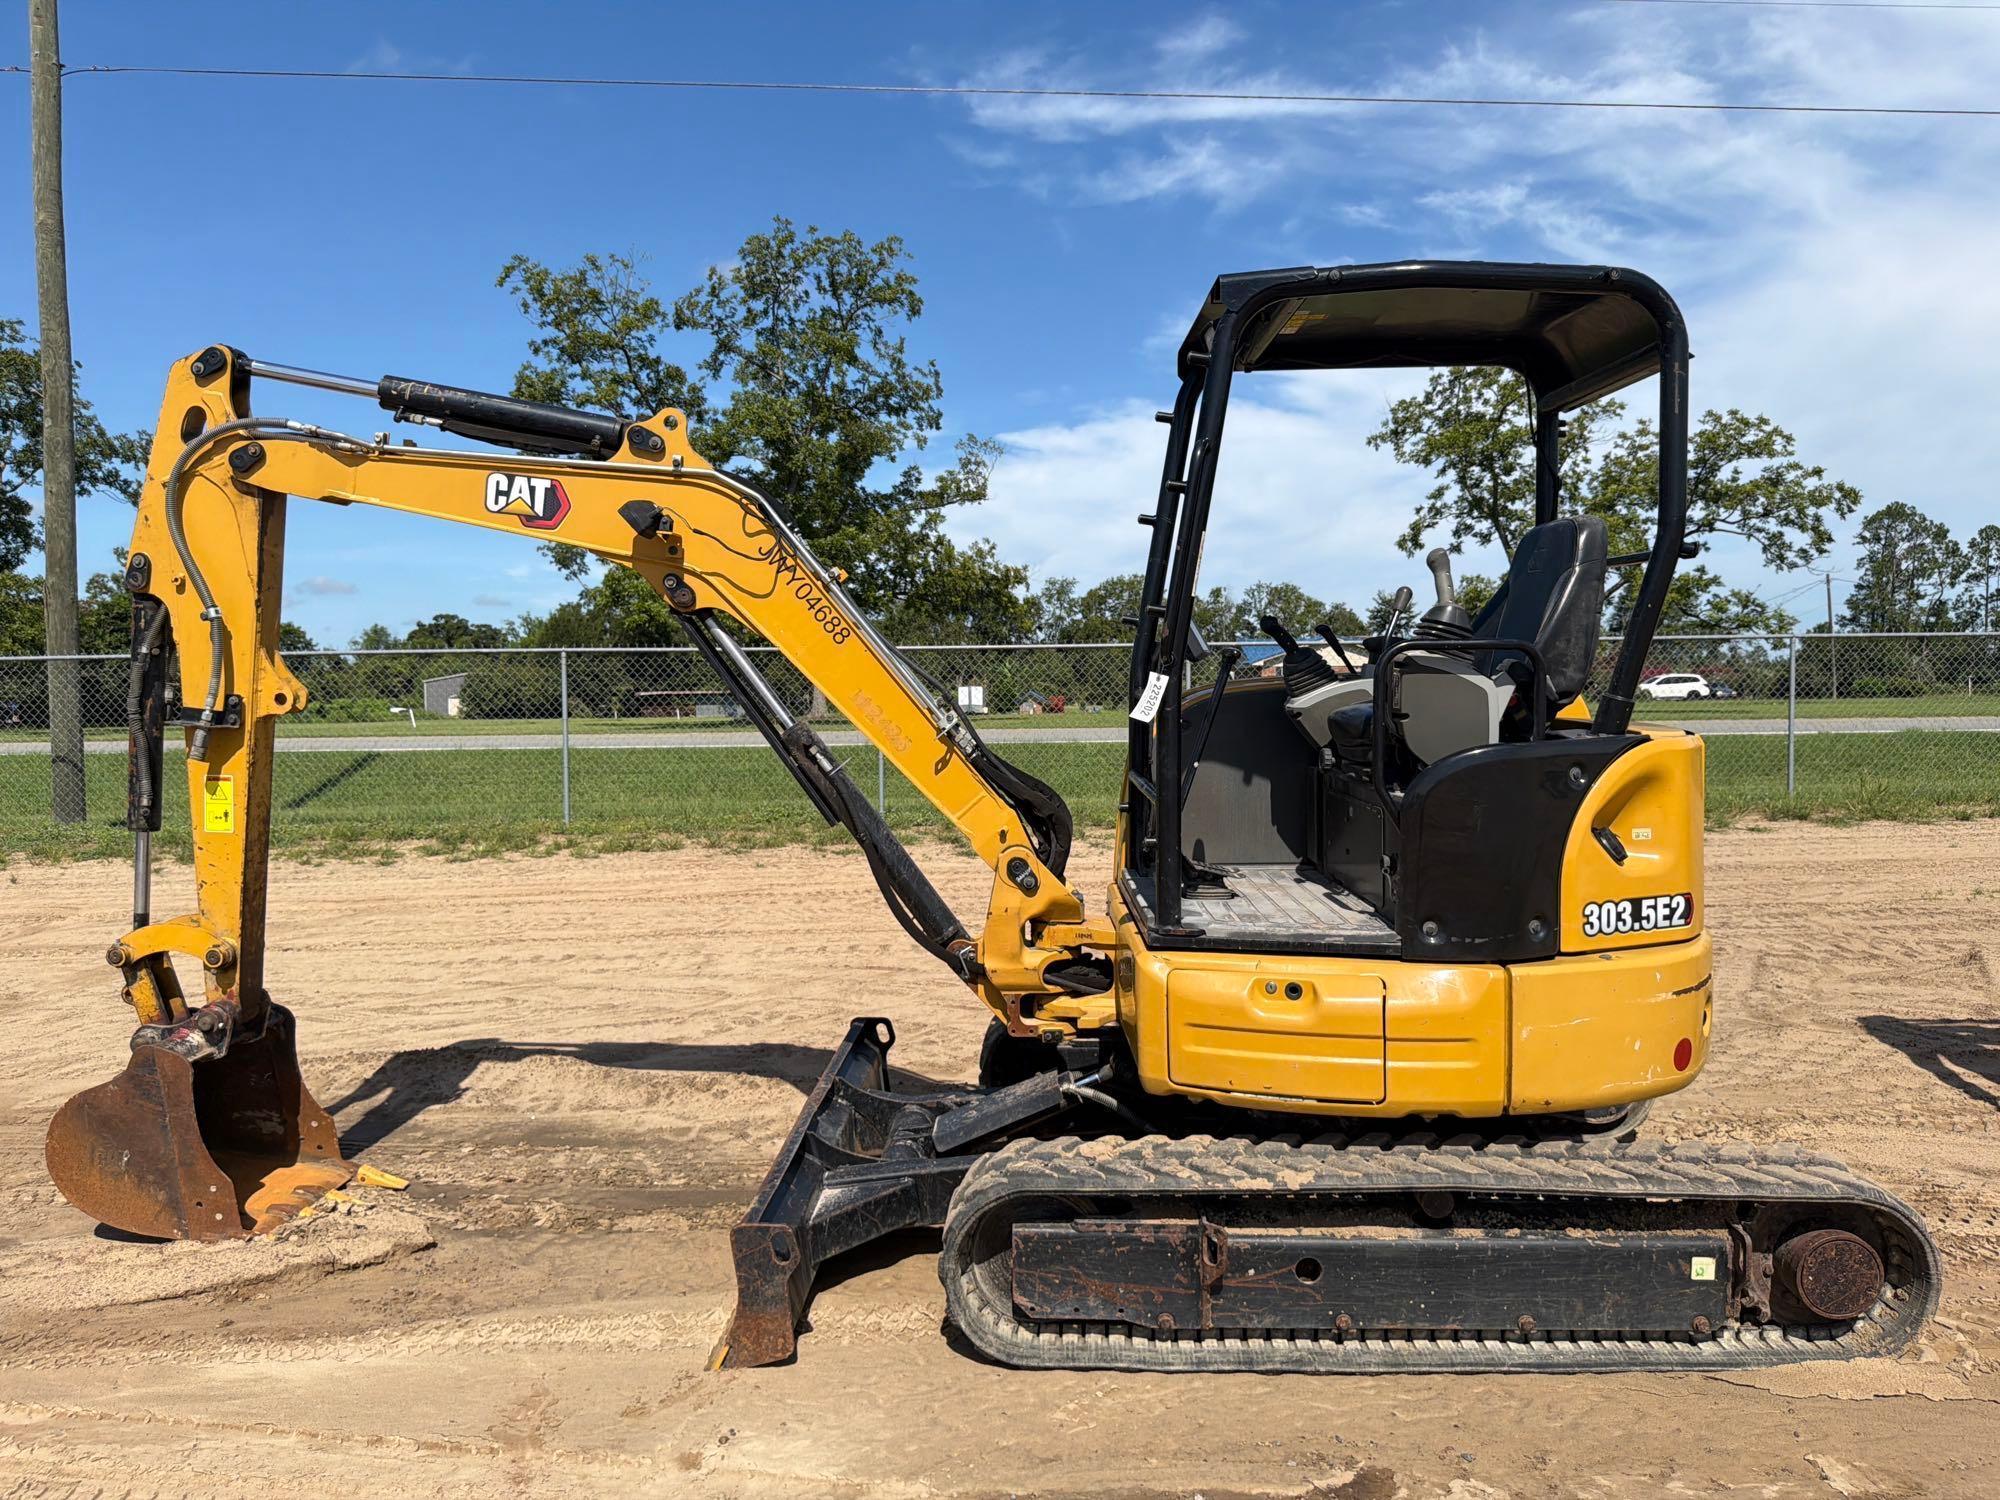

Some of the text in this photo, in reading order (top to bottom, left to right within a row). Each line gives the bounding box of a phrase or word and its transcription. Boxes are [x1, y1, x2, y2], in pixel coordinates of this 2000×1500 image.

[487, 472, 552, 518] CAT
[758, 544, 851, 645] JWY04688
[1140, 683, 1162, 717] 225202
[1584, 895, 1686, 936] 303.5E2
